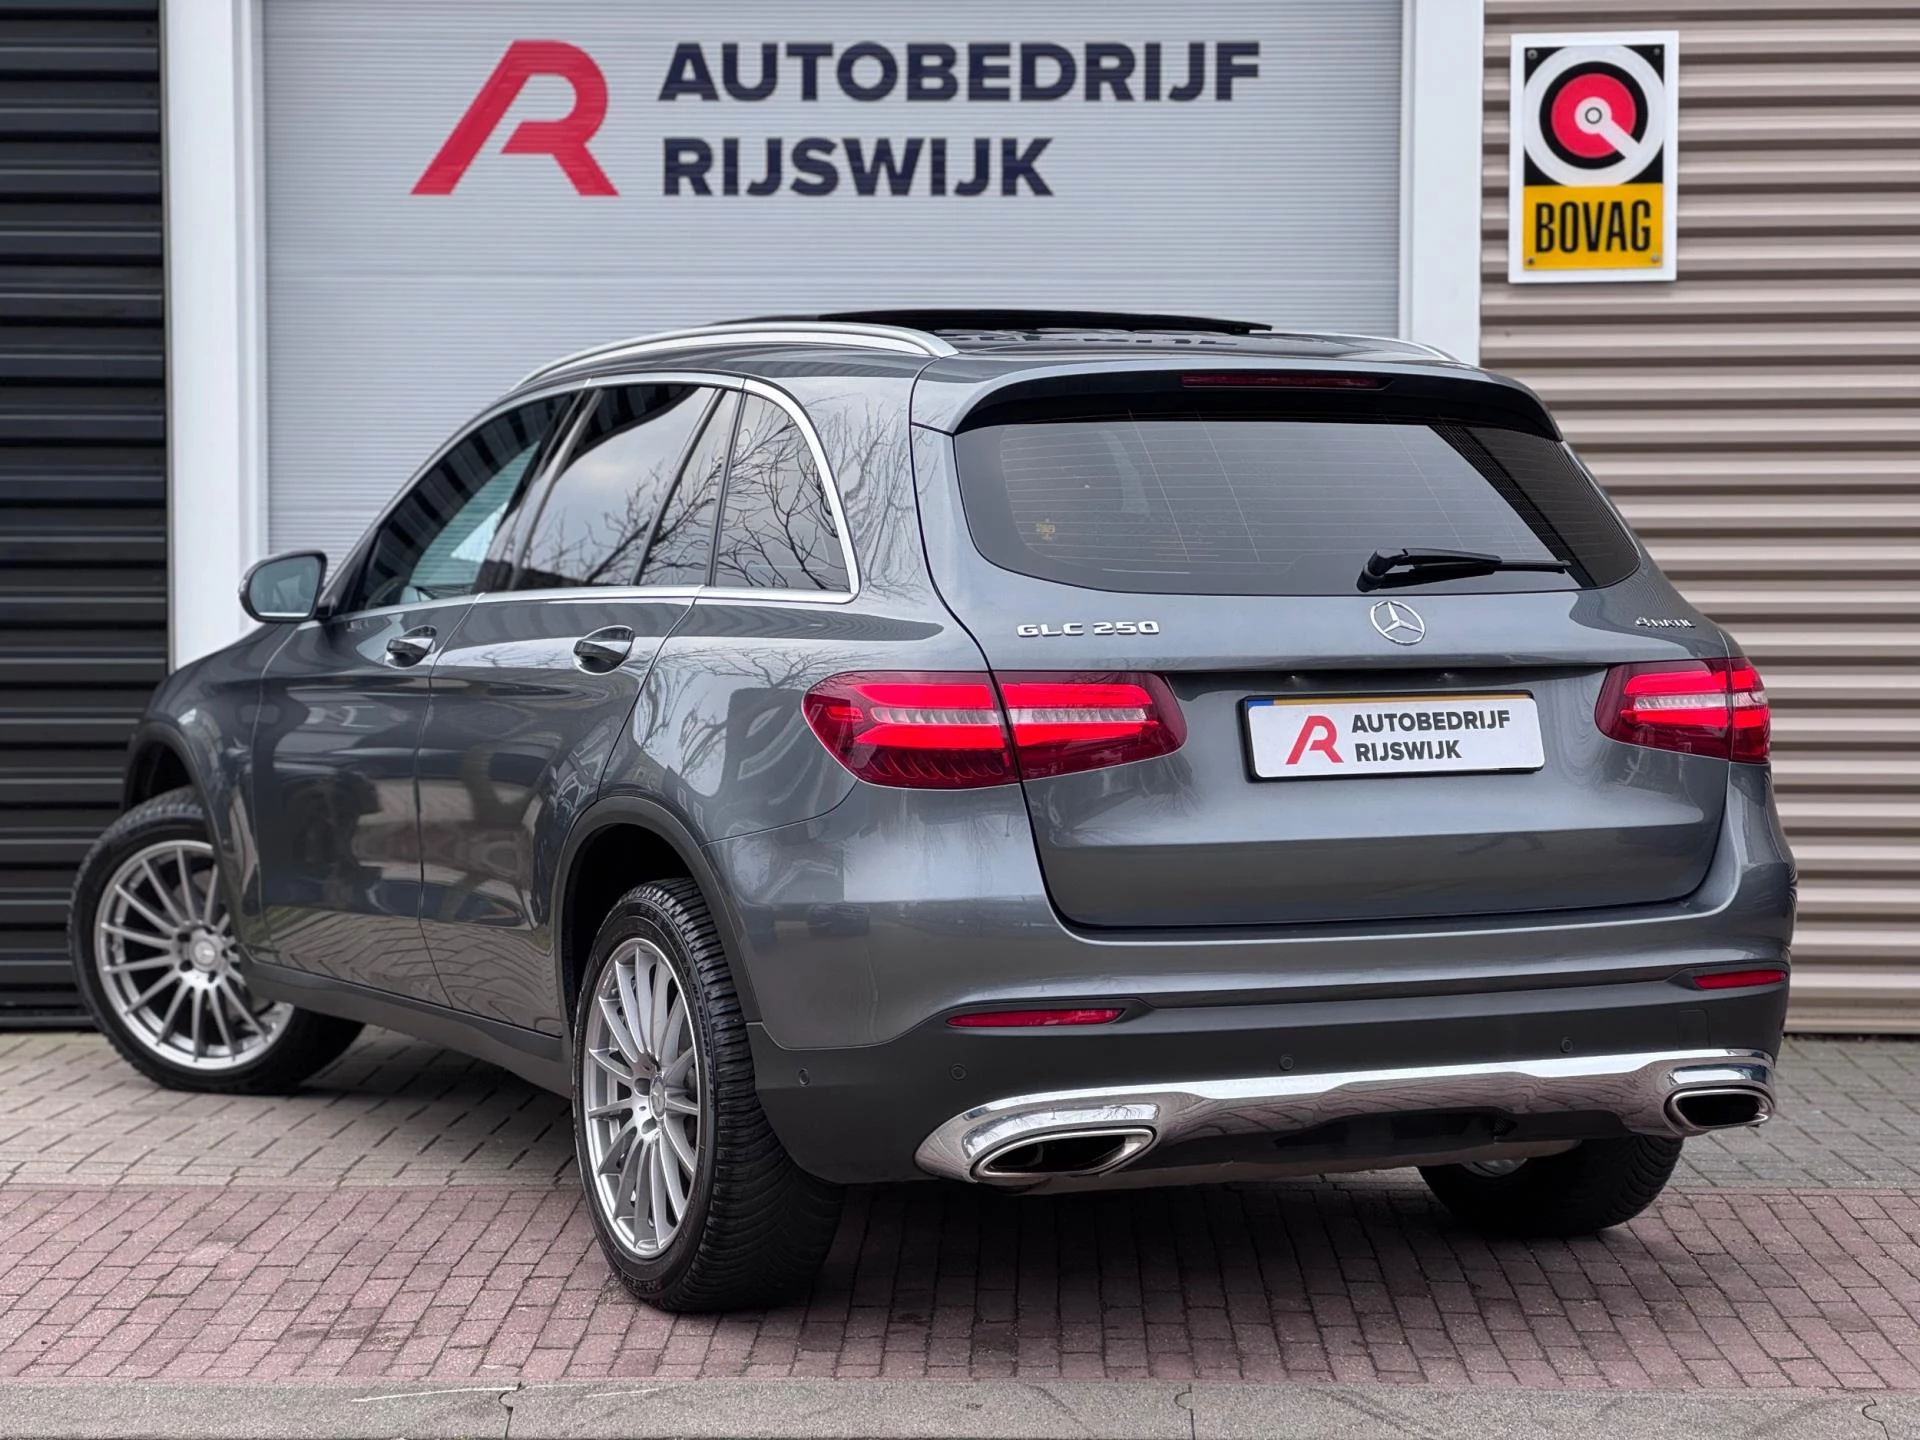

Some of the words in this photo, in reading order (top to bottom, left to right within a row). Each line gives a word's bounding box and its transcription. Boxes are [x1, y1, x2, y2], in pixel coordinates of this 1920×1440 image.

[659, 42, 1260, 101] AUTOBEDRIJF
[664, 137, 1054, 196] RIJSWIJK
[1535, 200, 1651, 253] BOVAG
[1016, 622, 1084, 637] GLC
[1093, 620, 1160, 635] 250
[1352, 710, 1511, 733] AUTOBEDRIJF
[1355, 740, 1462, 762] RIJSWIJK
